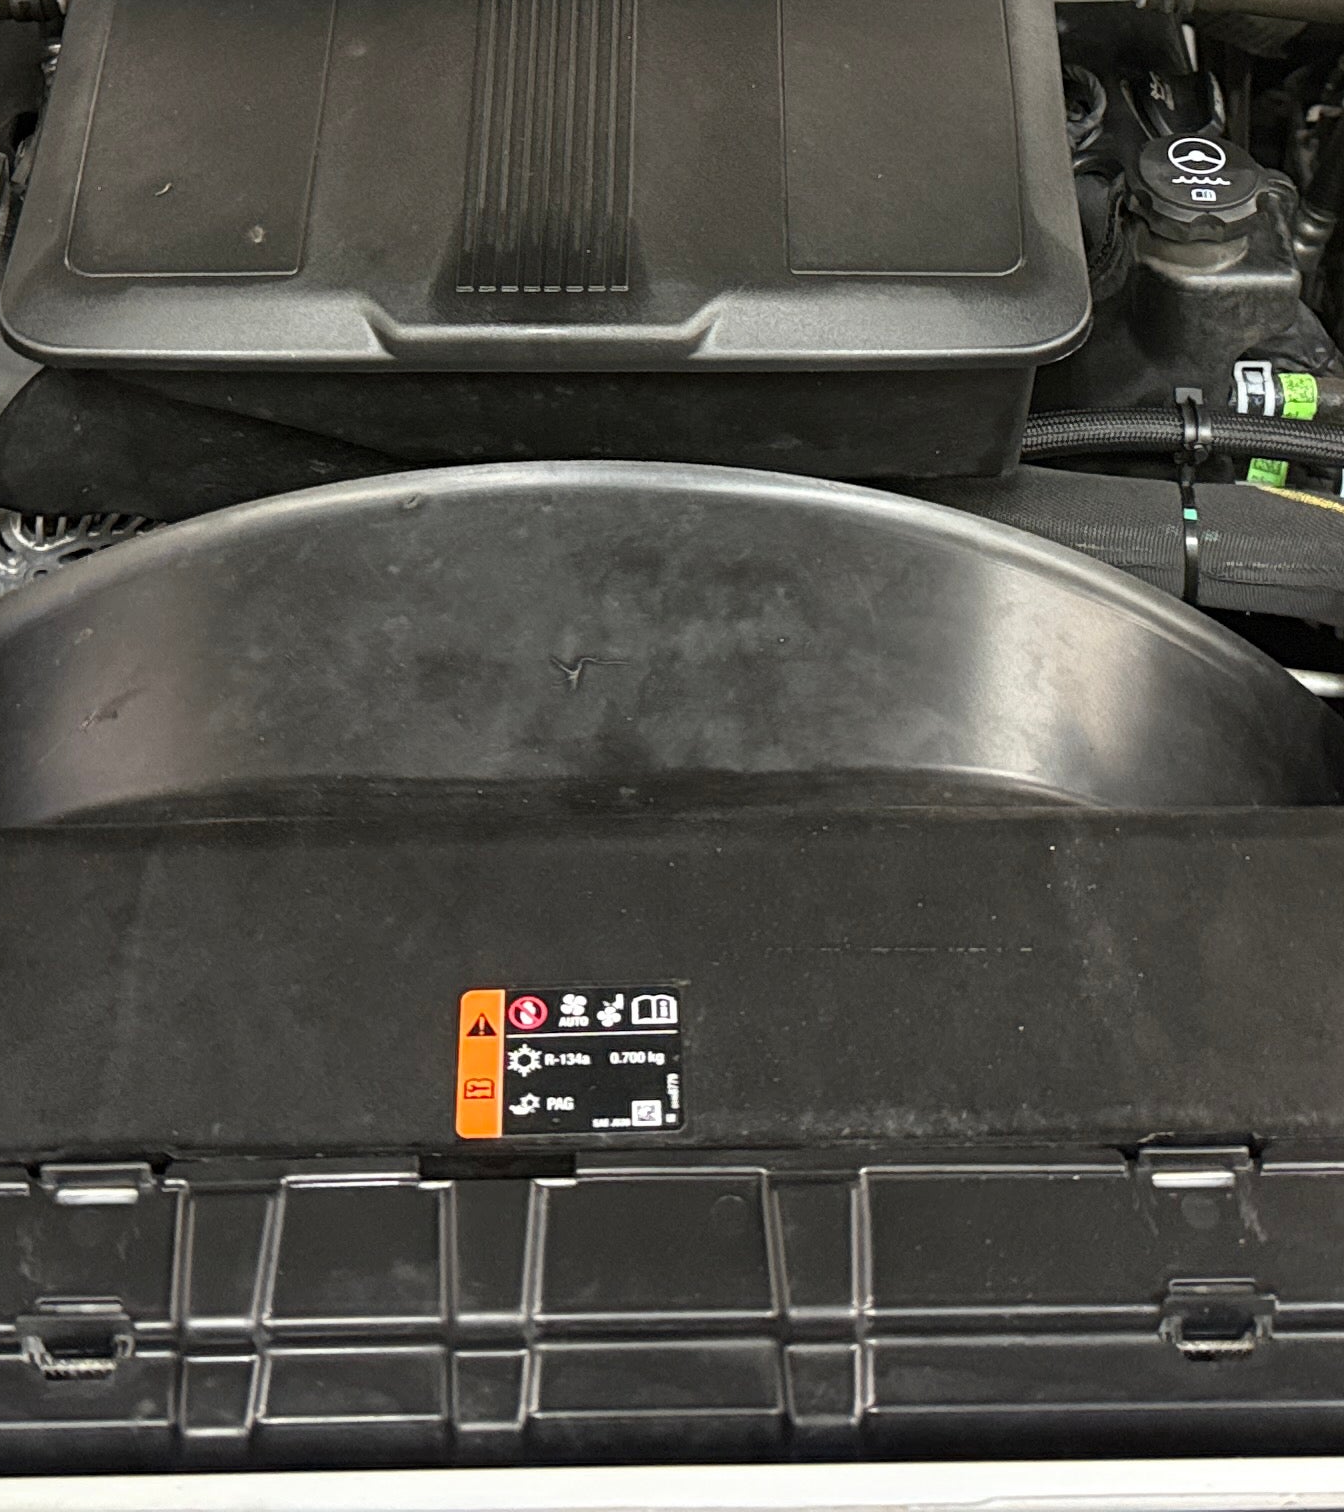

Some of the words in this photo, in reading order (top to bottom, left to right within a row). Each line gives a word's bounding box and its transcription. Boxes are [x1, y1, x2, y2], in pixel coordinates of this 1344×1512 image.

[558, 1016, 589, 1027] AUTO
[544, 1053, 591, 1065] R-134a
[609, 1051, 647, 1065] 0.700
[647, 1050, 666, 1066] kg
[546, 1096, 575, 1111] PAG
